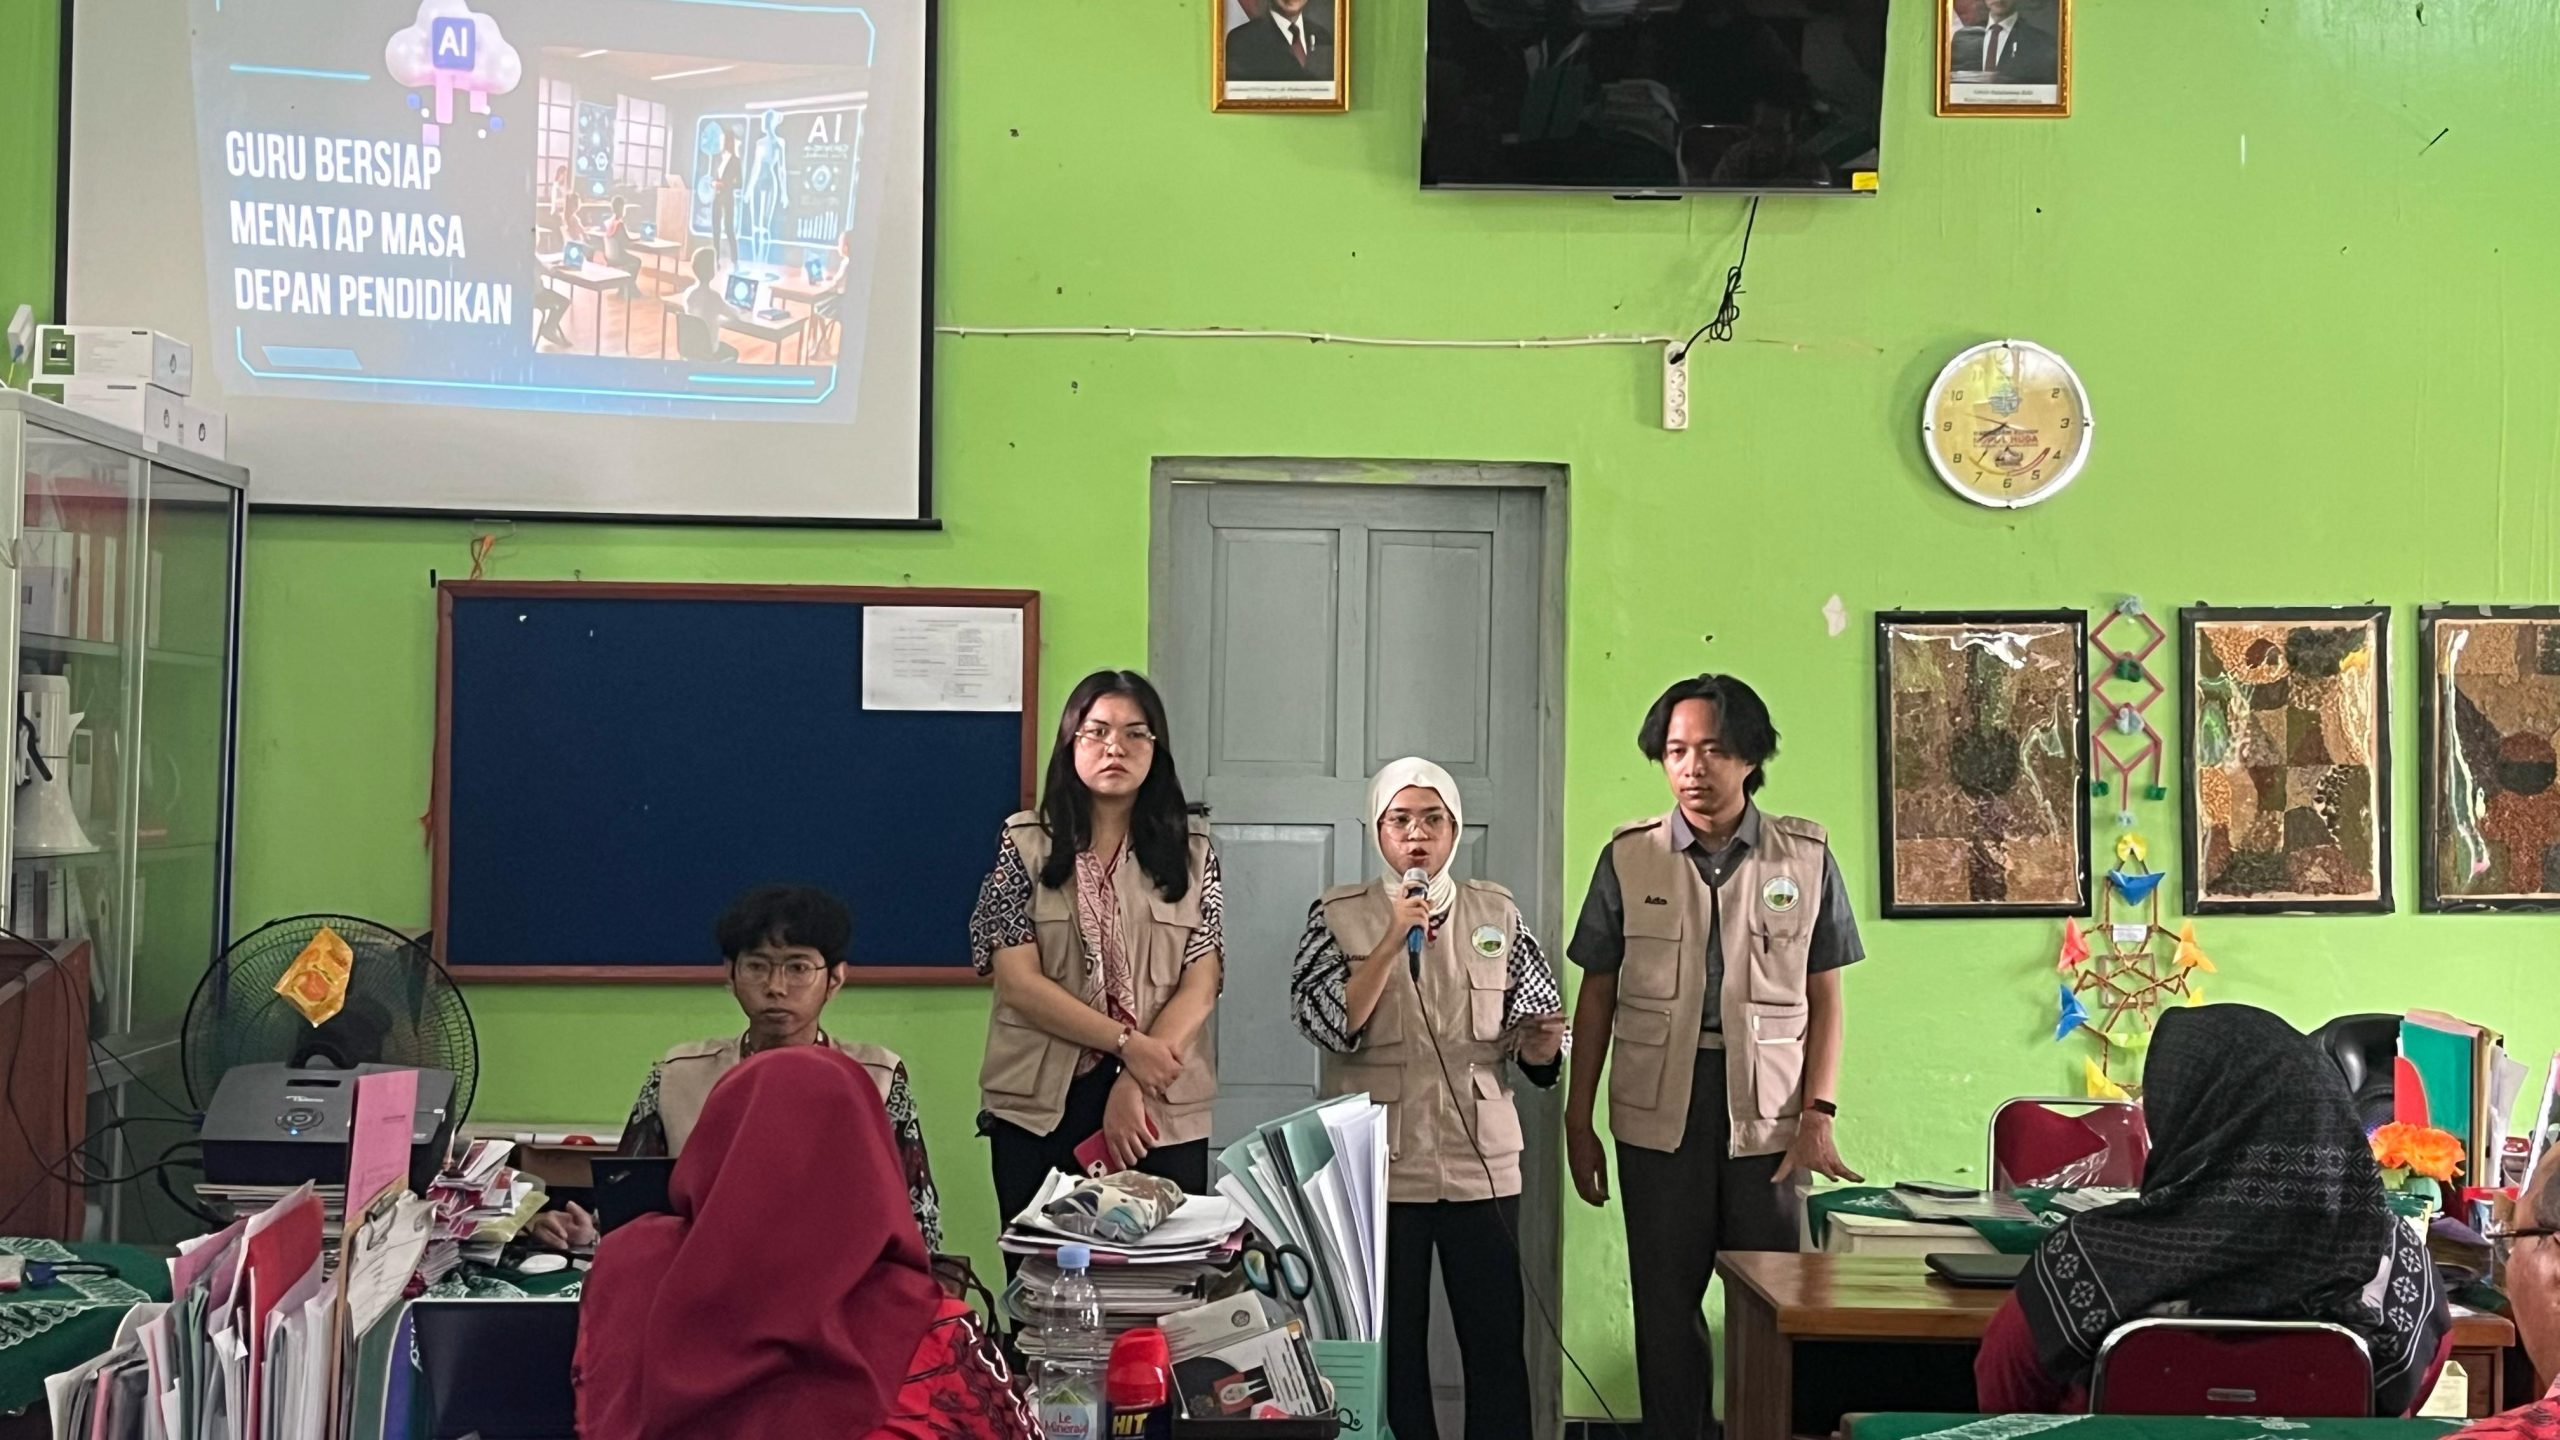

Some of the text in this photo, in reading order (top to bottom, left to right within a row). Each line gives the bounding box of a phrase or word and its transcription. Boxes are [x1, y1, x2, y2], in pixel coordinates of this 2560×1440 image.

[438, 26, 468, 57] AI
[808, 113, 842, 143] AI
[225, 130, 442, 190] GURU BERSIAP
[229, 200, 466, 258] MENATAP MASA
[234, 267, 512, 325] DEPAN PENDIDIKAN
[1951, 390, 1964, 401] 10
[2051, 388, 2060, 399] 2
[1943, 421, 1952, 432] 9
[2060, 418, 2070, 429] 3
[1953, 453, 1962, 464] 8
[2052, 449, 2062, 460] 4
[1974, 471, 1983, 483] 7
[2031, 470, 2041, 481] 5
[2003, 478, 2012, 489] 6
[1058, 1411, 1072, 1423] Le
[1112, 1412, 1150, 1435] HIT
